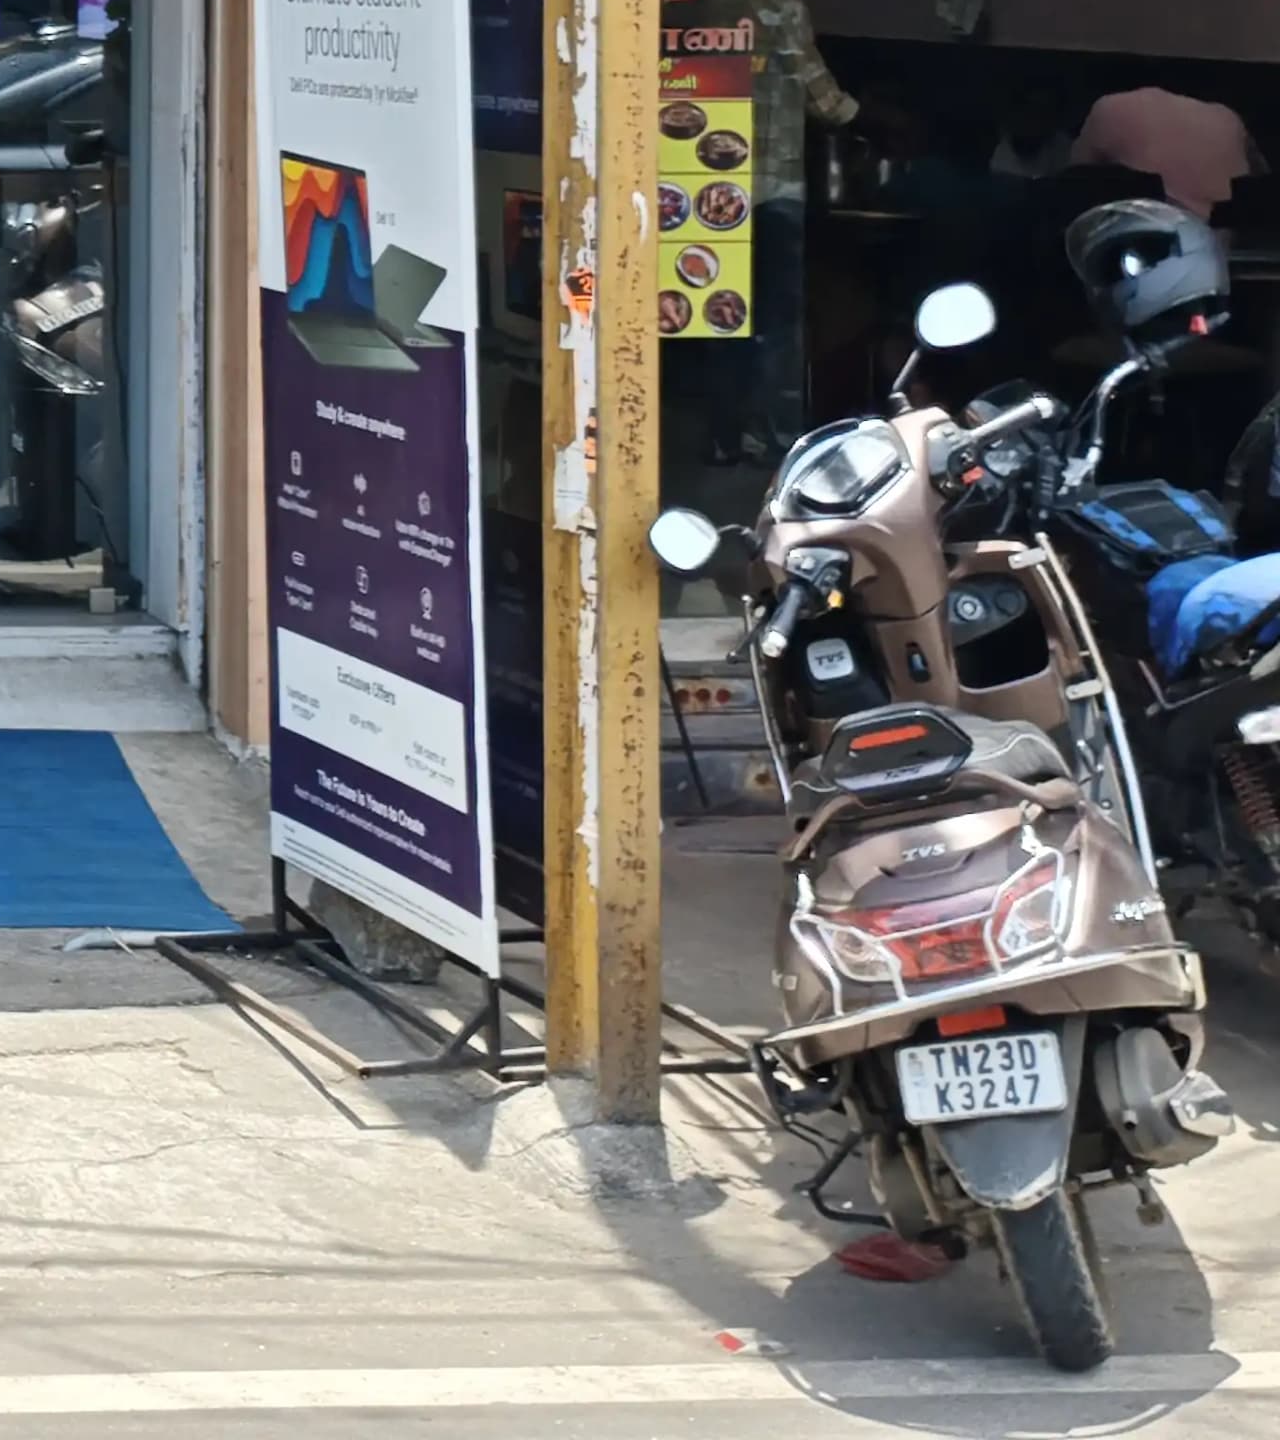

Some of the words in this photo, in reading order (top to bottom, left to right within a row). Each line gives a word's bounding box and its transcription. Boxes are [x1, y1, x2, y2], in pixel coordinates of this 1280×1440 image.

[305, 17, 401, 72] productivity
[902, 843, 946, 862] TVS
[928, 1038, 1040, 1078] TN23D
[937, 1074, 1041, 1116] K3247
